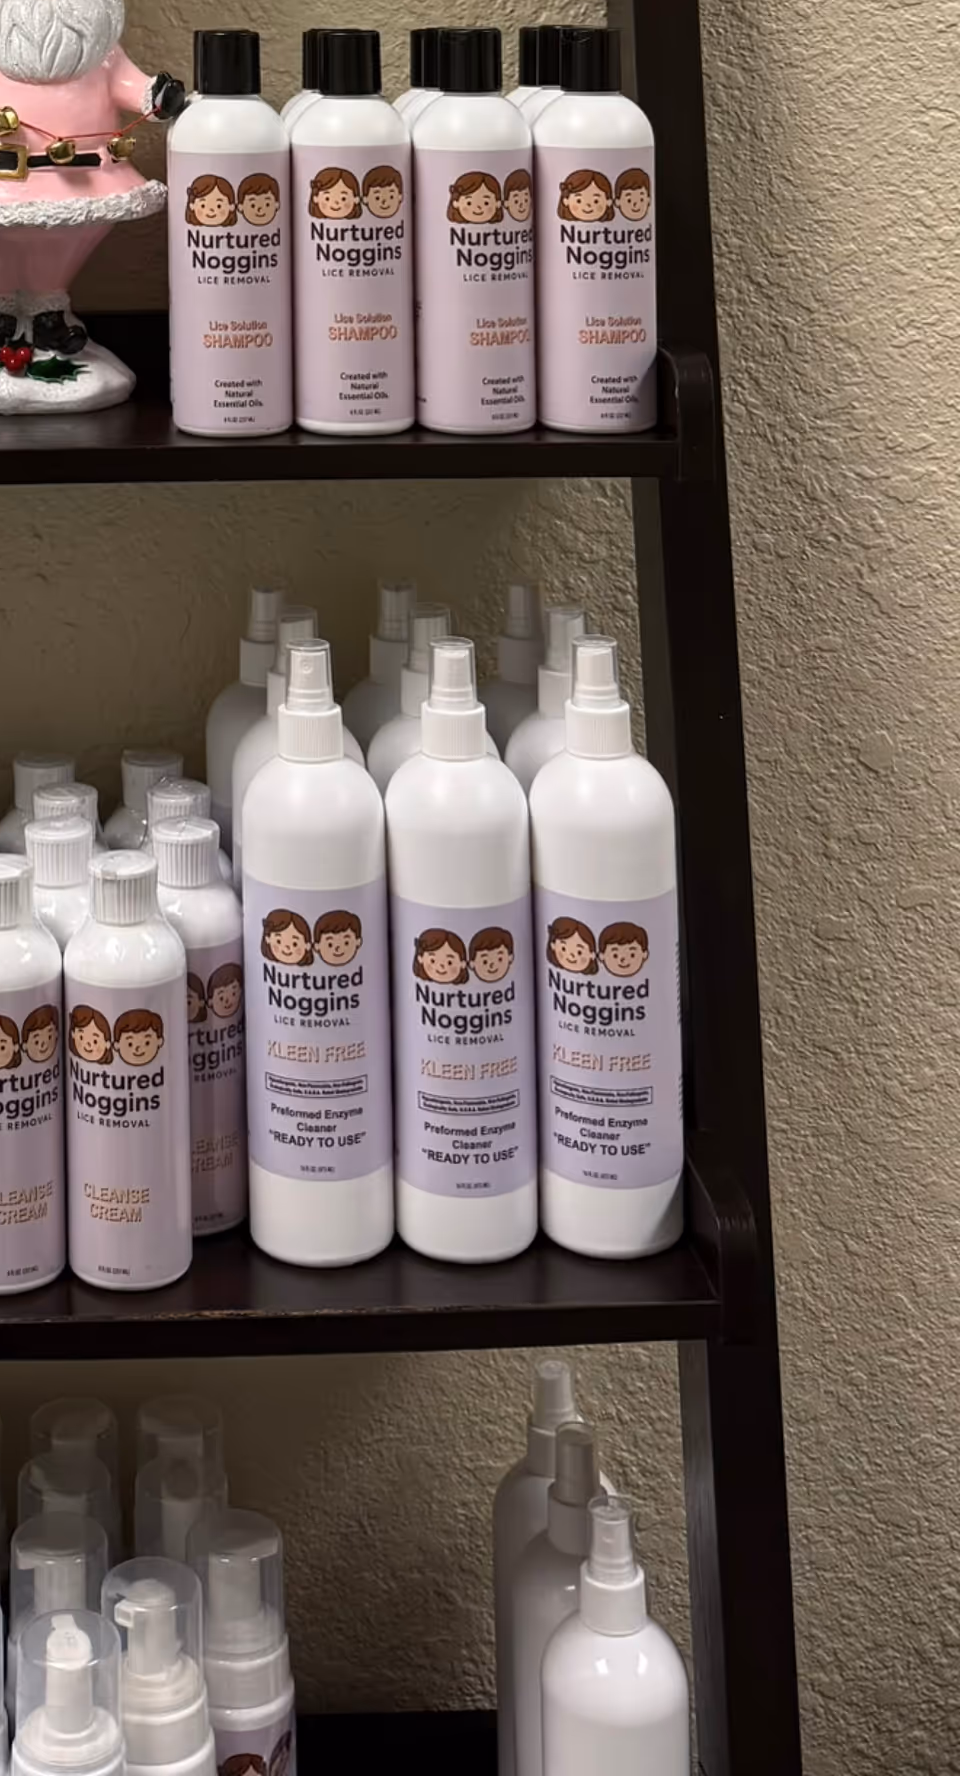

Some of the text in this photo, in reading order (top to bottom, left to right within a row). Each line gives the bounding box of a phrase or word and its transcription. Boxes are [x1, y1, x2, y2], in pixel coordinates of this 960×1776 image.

[187, 228, 280, 249] Nurtured
[311, 221, 403, 241] Nurtured
[560, 225, 652, 244] Nurtured
[193, 251, 277, 274] Noggins
[316, 243, 401, 266] Noggins
[457, 246, 533, 271] Noggins
[566, 247, 649, 269] Noggins
[322, 267, 394, 277] LICE REMOVAL
[463, 274, 486, 282] LICE
[573, 272, 595, 280] LICE
[198, 276, 270, 285] LICE REMOVAL
[210, 321, 228, 331] Lice
[335, 314, 353, 323] Lice
[203, 333, 273, 349] SHAMPOO
[329, 326, 397, 341] SHAMPOO
[579, 329, 646, 344] SHAMPOO
[215, 380, 244, 388] Created
[340, 372, 370, 380] Created
[591, 376, 621, 384] Created
[225, 390, 253, 398] Natural
[214, 400, 247, 408] Essential
[263, 963, 363, 991] Nurtured
[548, 969, 649, 1000] Nurtured
[269, 987, 359, 1016] Noggins
[416, 981, 515, 1008] Nurtured
[553, 992, 646, 1026] Noggins
[274, 1015, 350, 1028] LICE REMOVAL
[422, 1006, 512, 1034] Noggins
[559, 1021, 635, 1037] LICE REMOVAL
[428, 1034, 504, 1045] LICE REMOVAL
[268, 1040, 365, 1063] KLEEN FREE
[553, 1044, 651, 1072] KLEEN FREE
[70, 1058, 164, 1090] Nurtured
[421, 1056, 518, 1080] KLEEN FREE
[73, 1081, 160, 1117] Noggins
[271, 1103, 363, 1120] Preformed Enzyme
[555, 1106, 648, 1130] Preformed Enzyme
[7, 1114, 52, 1131] REMOVAL
[77, 1112, 149, 1128] LICE REMOVAL
[297, 1122, 337, 1132] Cleaner
[424, 1122, 515, 1136] Preformed Enzyme
[580, 1127, 620, 1140] Cleaner
[317, 1137, 334, 1148] TO
[452, 1140, 492, 1149] Cleaner
[600, 1144, 618, 1156] TO
[473, 1154, 489, 1164] TO
[84, 1182, 149, 1204] CLEANSE
[90, 1204, 142, 1223] CREAM
